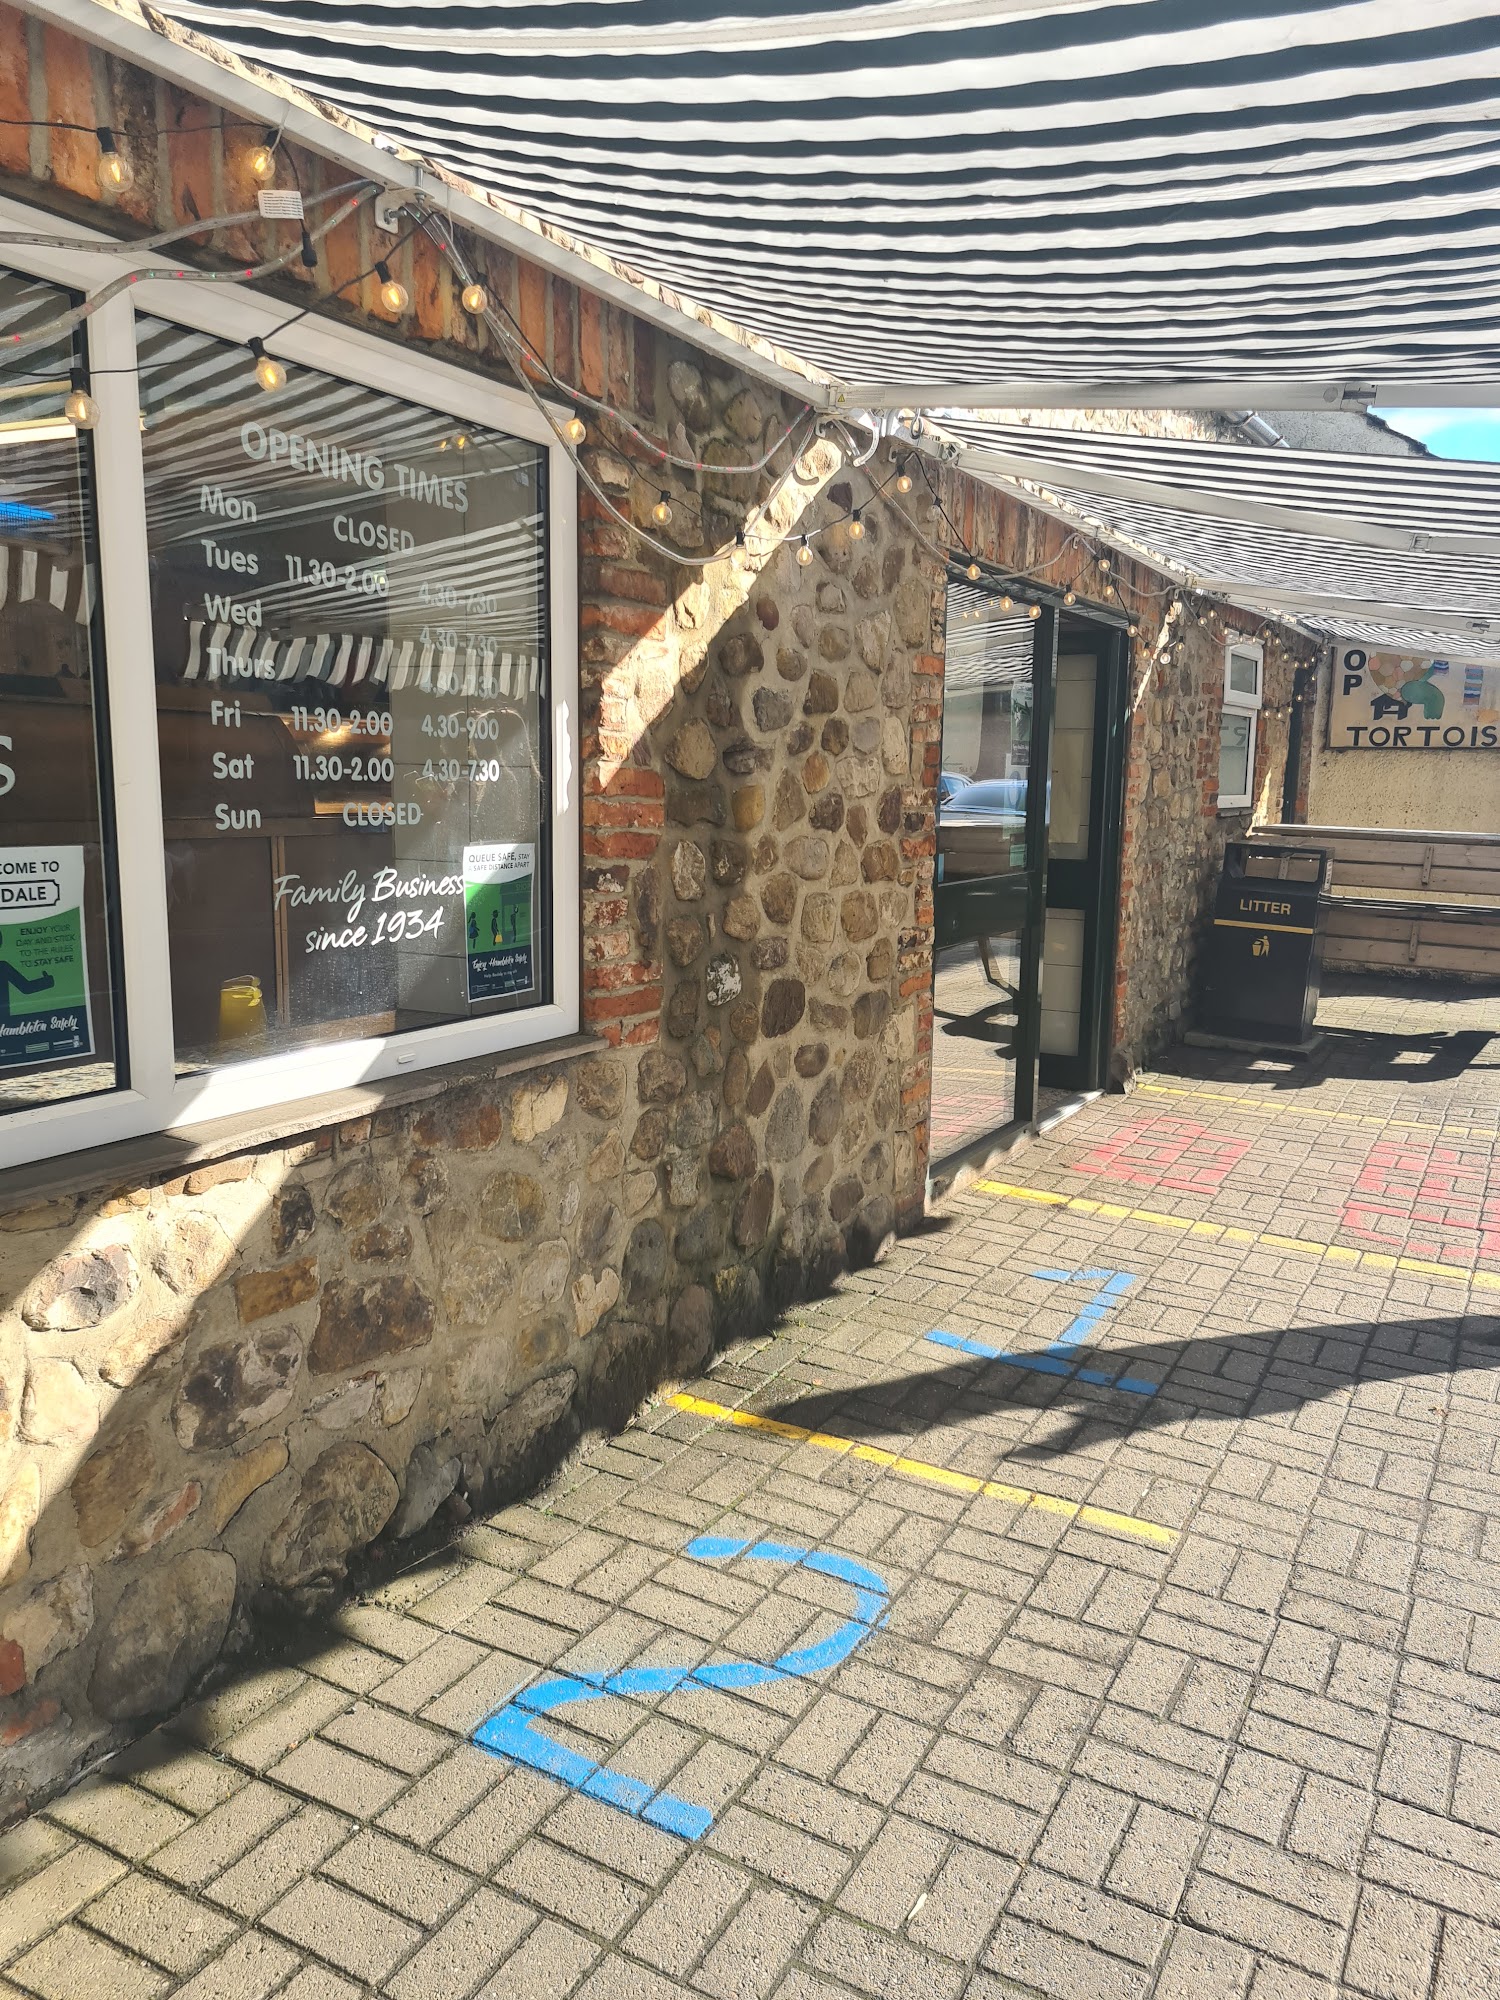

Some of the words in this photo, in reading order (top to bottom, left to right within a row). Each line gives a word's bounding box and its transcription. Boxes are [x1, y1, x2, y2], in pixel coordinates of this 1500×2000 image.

[241, 421, 386, 491] OPENING
[393, 463, 469, 513] TIMES
[200, 484, 258, 523] Mon
[333, 514, 415, 555] CLOSED
[201, 539, 260, 576] Tues
[285, 554, 390, 597] 11.30-2.00
[418, 581, 498, 617] 4.30-7.30
[204, 593, 263, 628] Wed
[206, 647, 276, 681] Thurs
[211, 700, 241, 728] Fri
[290, 705, 394, 737] 11.30-2.00
[421, 714, 500, 741] 4.30-9.00
[1346, 724, 1498, 747] TORTOIS
[212, 752, 255, 781] Sat
[292, 754, 395, 783] 11.30-2.00
[421, 758, 500, 783] 4.30-7.30
[214, 803, 262, 831] Sun
[342, 802, 422, 827] CLOSED
[0, 861, 38, 875] OME
[41, 860, 60, 873] TO
[468, 853, 496, 863] QUEUE
[497, 851, 517, 862] SAFE,
[518, 853, 531, 861] STAY
[473, 864, 487, 872] SAFE
[488, 861, 514, 871] DISTANCE
[514, 861, 530, 869] APART
[273, 869, 366, 924] Family
[371, 866, 464, 902] Business
[1239, 898, 1291, 915] LITTER
[16, 938, 33, 947] DAY
[54, 933, 76, 943] STICK
[20, 926, 48, 936] ENJOY
[305, 926, 368, 954] since
[371, 905, 445, 945] 1934
[34, 957, 53, 967] STAY
[54, 954, 74, 964] SAFE
[50, 1014, 80, 1032] Safely
[469, 1536, 891, 1843] 2
